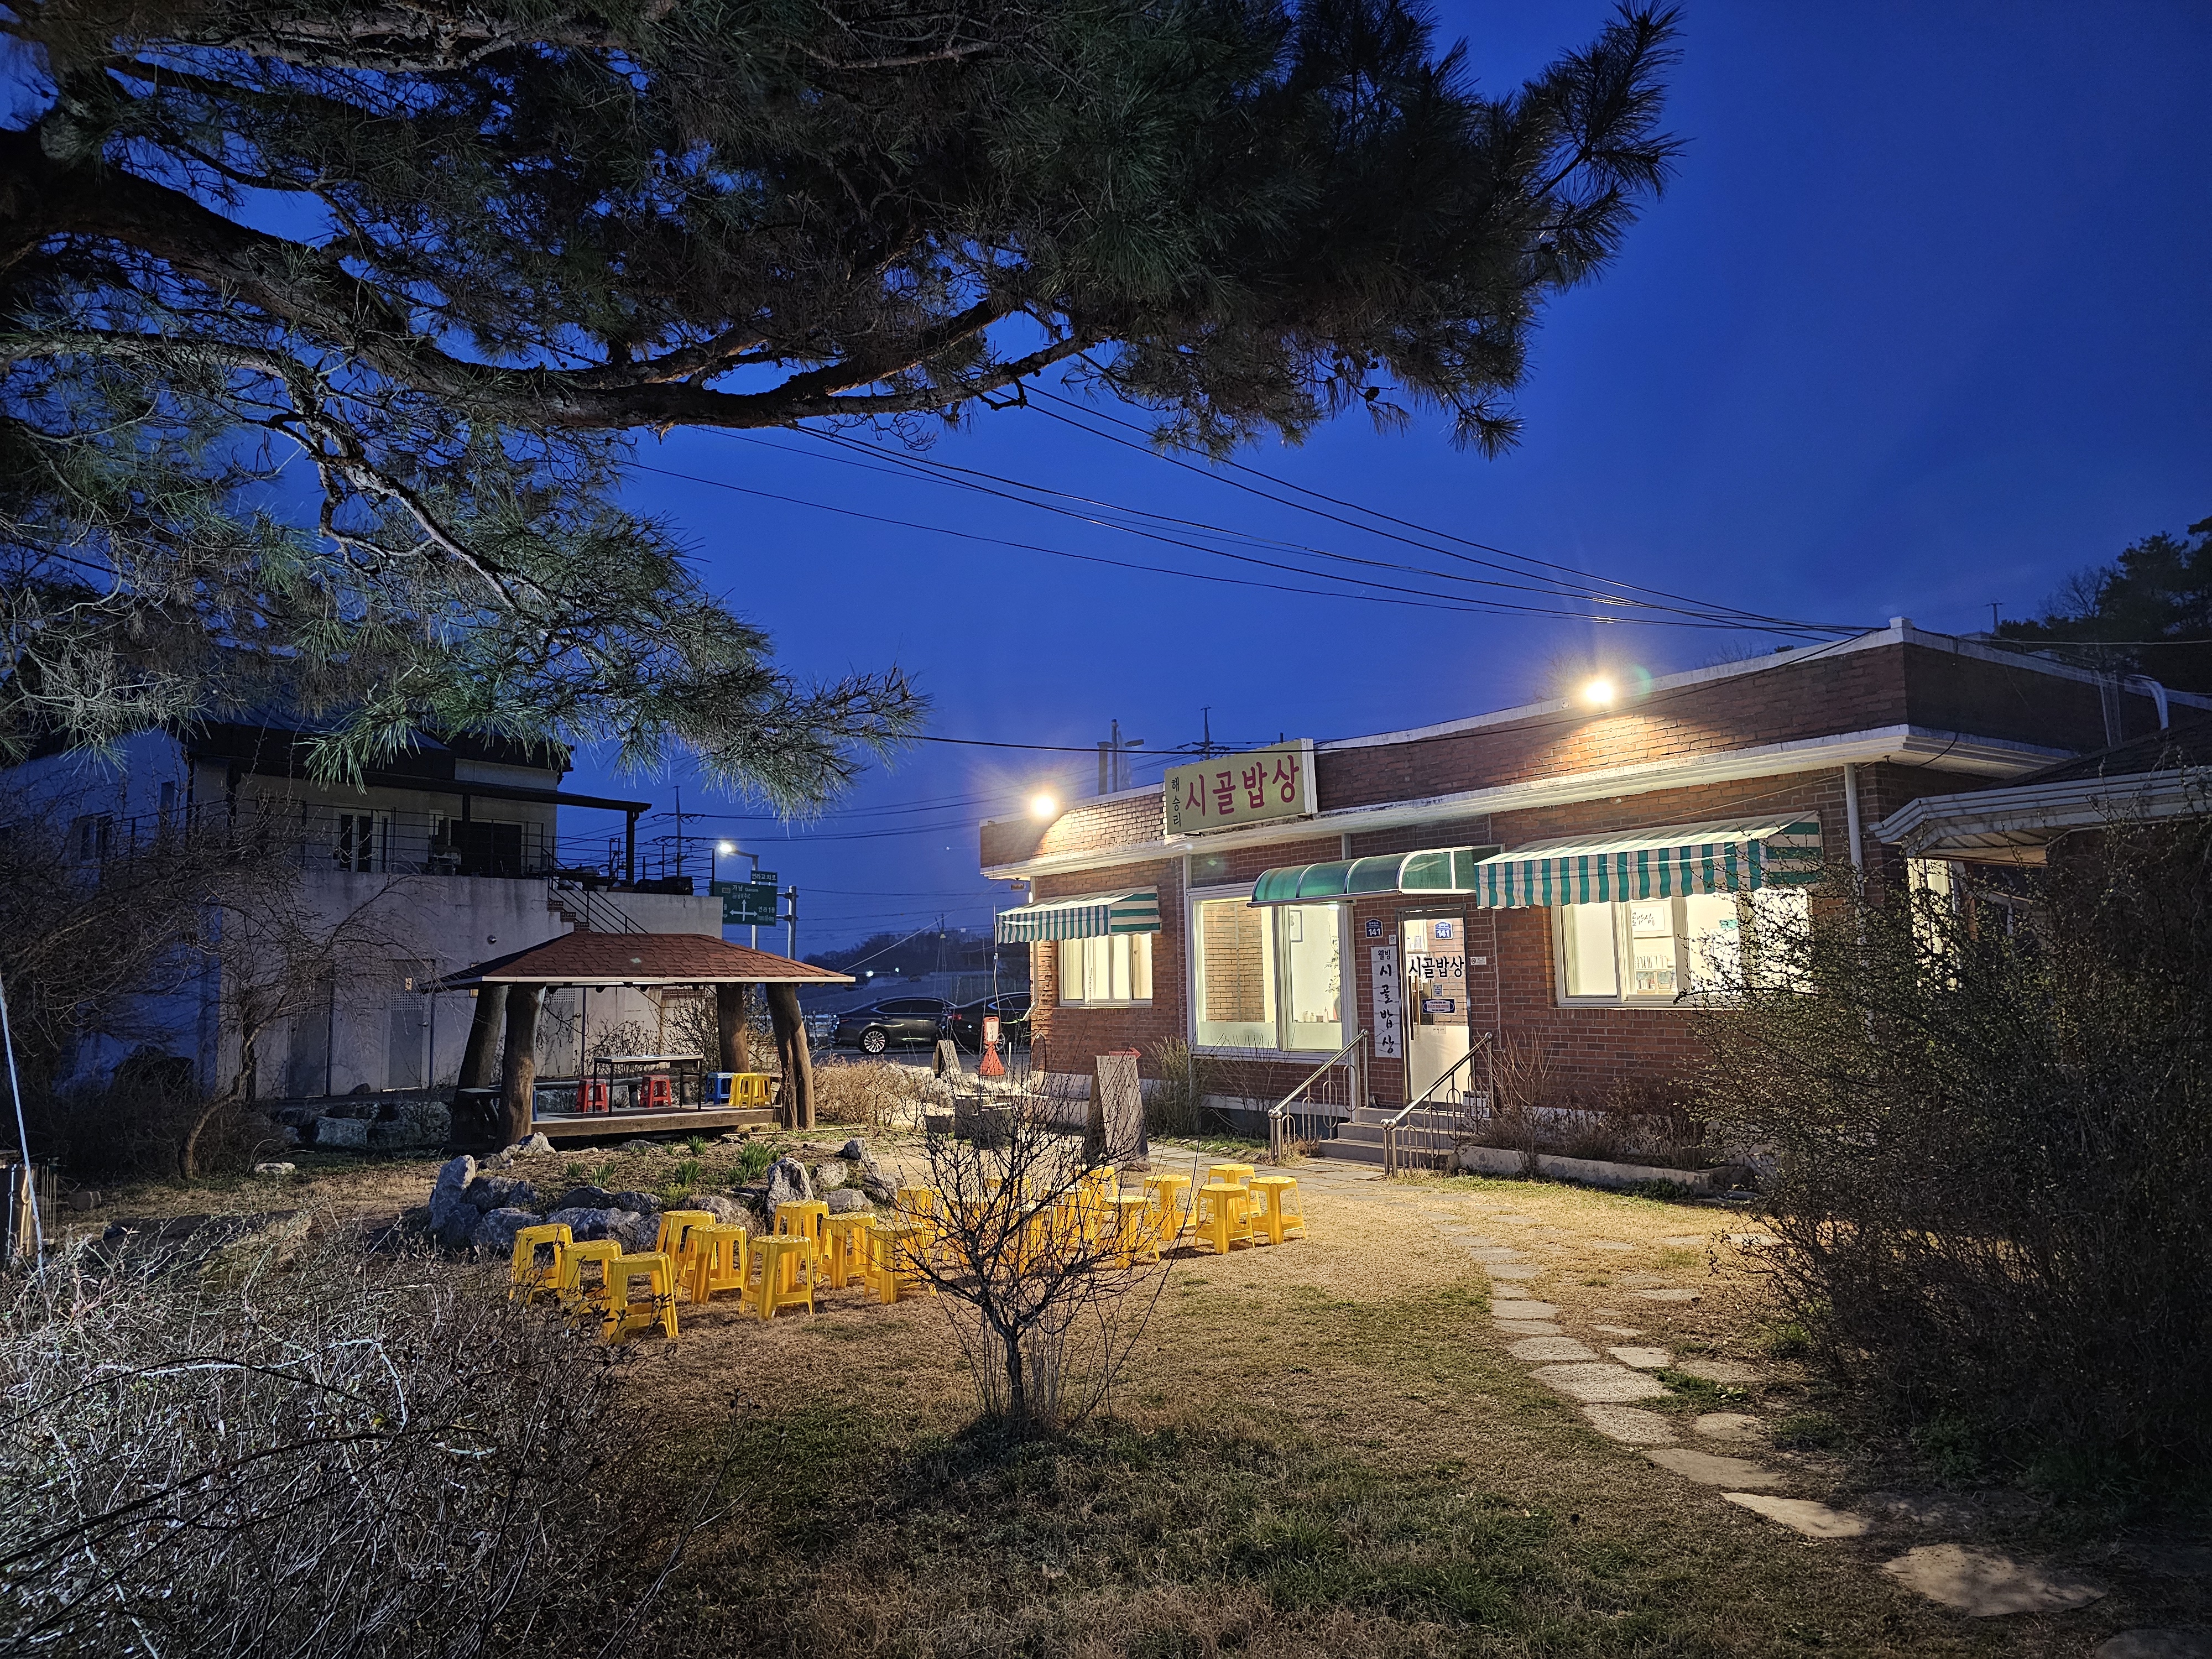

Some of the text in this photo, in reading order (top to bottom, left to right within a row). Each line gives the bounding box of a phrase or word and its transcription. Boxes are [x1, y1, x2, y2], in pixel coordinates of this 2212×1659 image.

[1171, 776, 1181, 827] 해승리
[1185, 754, 1300, 817] 시골밥상
[1378, 950, 1391, 960] 웰빙
[1408, 955, 1465, 978] 시골밥상
[1379, 963, 1395, 1053] 시골밥상
